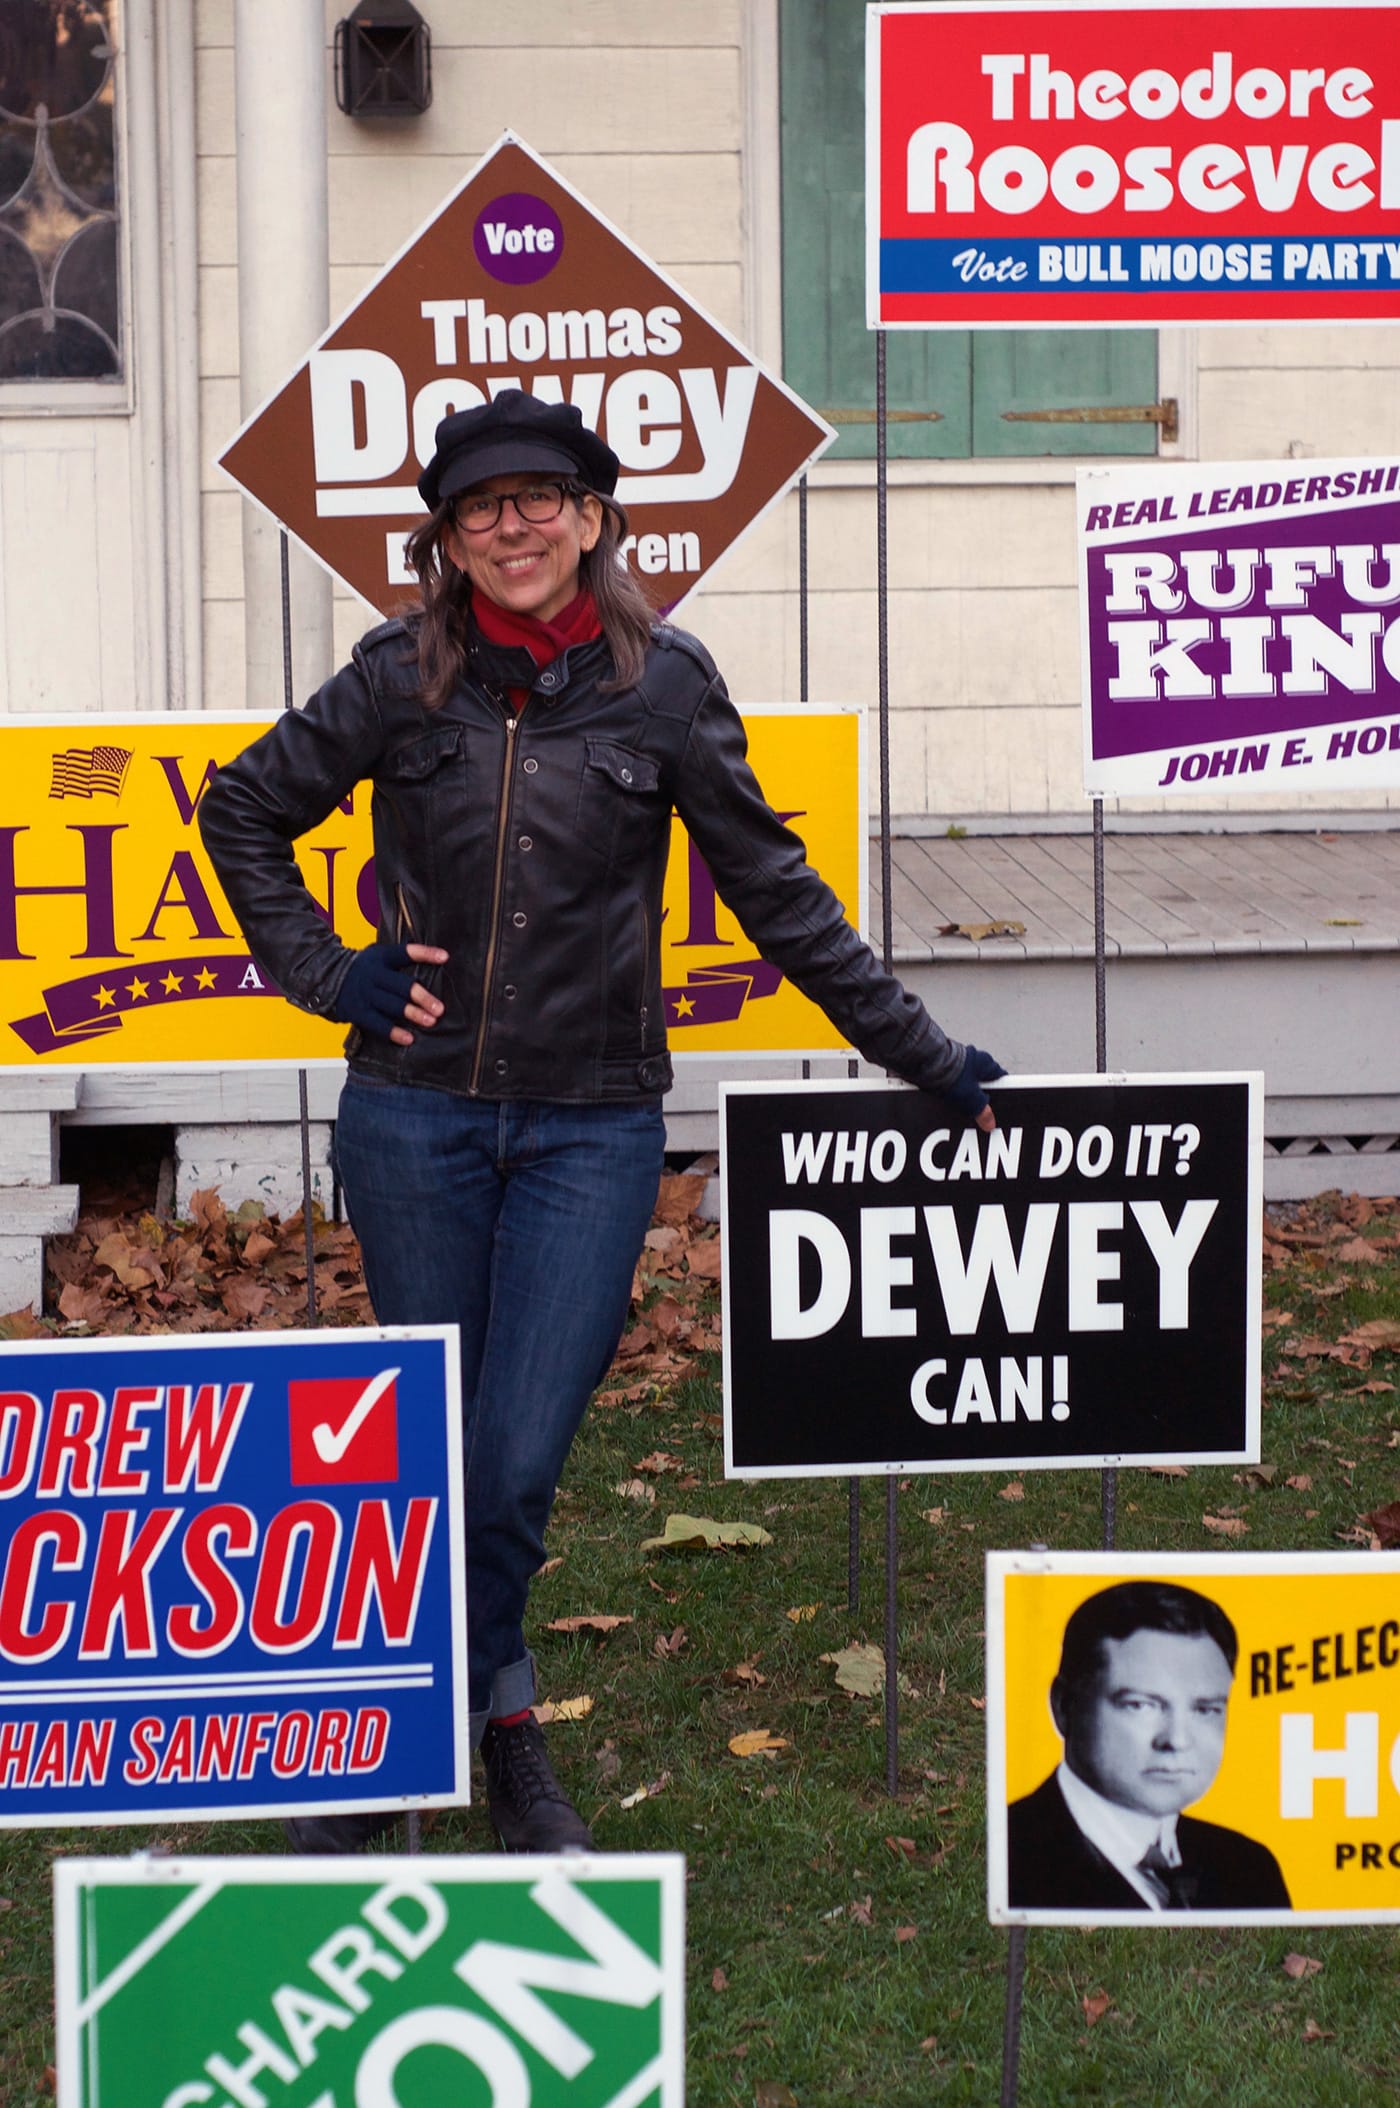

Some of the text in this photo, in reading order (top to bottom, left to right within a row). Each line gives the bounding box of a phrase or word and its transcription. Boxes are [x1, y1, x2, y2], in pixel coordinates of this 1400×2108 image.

[981, 52, 1375, 121] Theodore
[483, 222, 555, 255] Vote
[952, 242, 1400, 283] Vote BULL MOOSE PARTY
[421, 298, 682, 365] Thomas
[309, 348, 760, 506] Deey
[1085, 466, 1400, 532] REAL LEADERSHI
[1105, 543, 1400, 616] RUFU
[1107, 612, 1400, 702] KIN
[1158, 743, 1270, 787] JOHN
[1281, 738, 1313, 768] E.
[781, 1122, 1200, 1185] WHO CAN DO IT?
[768, 1198, 1219, 1341] DEWEY
[909, 1354, 1071, 1426] CAN!
[0, 1381, 254, 1500] DREW
[0, 1496, 440, 1666] CKSON
[1249, 1618, 1400, 1700] RE-ELEC
[123, 1705, 392, 1786] SANFORD
[305, 1872, 664, 2108] ON
